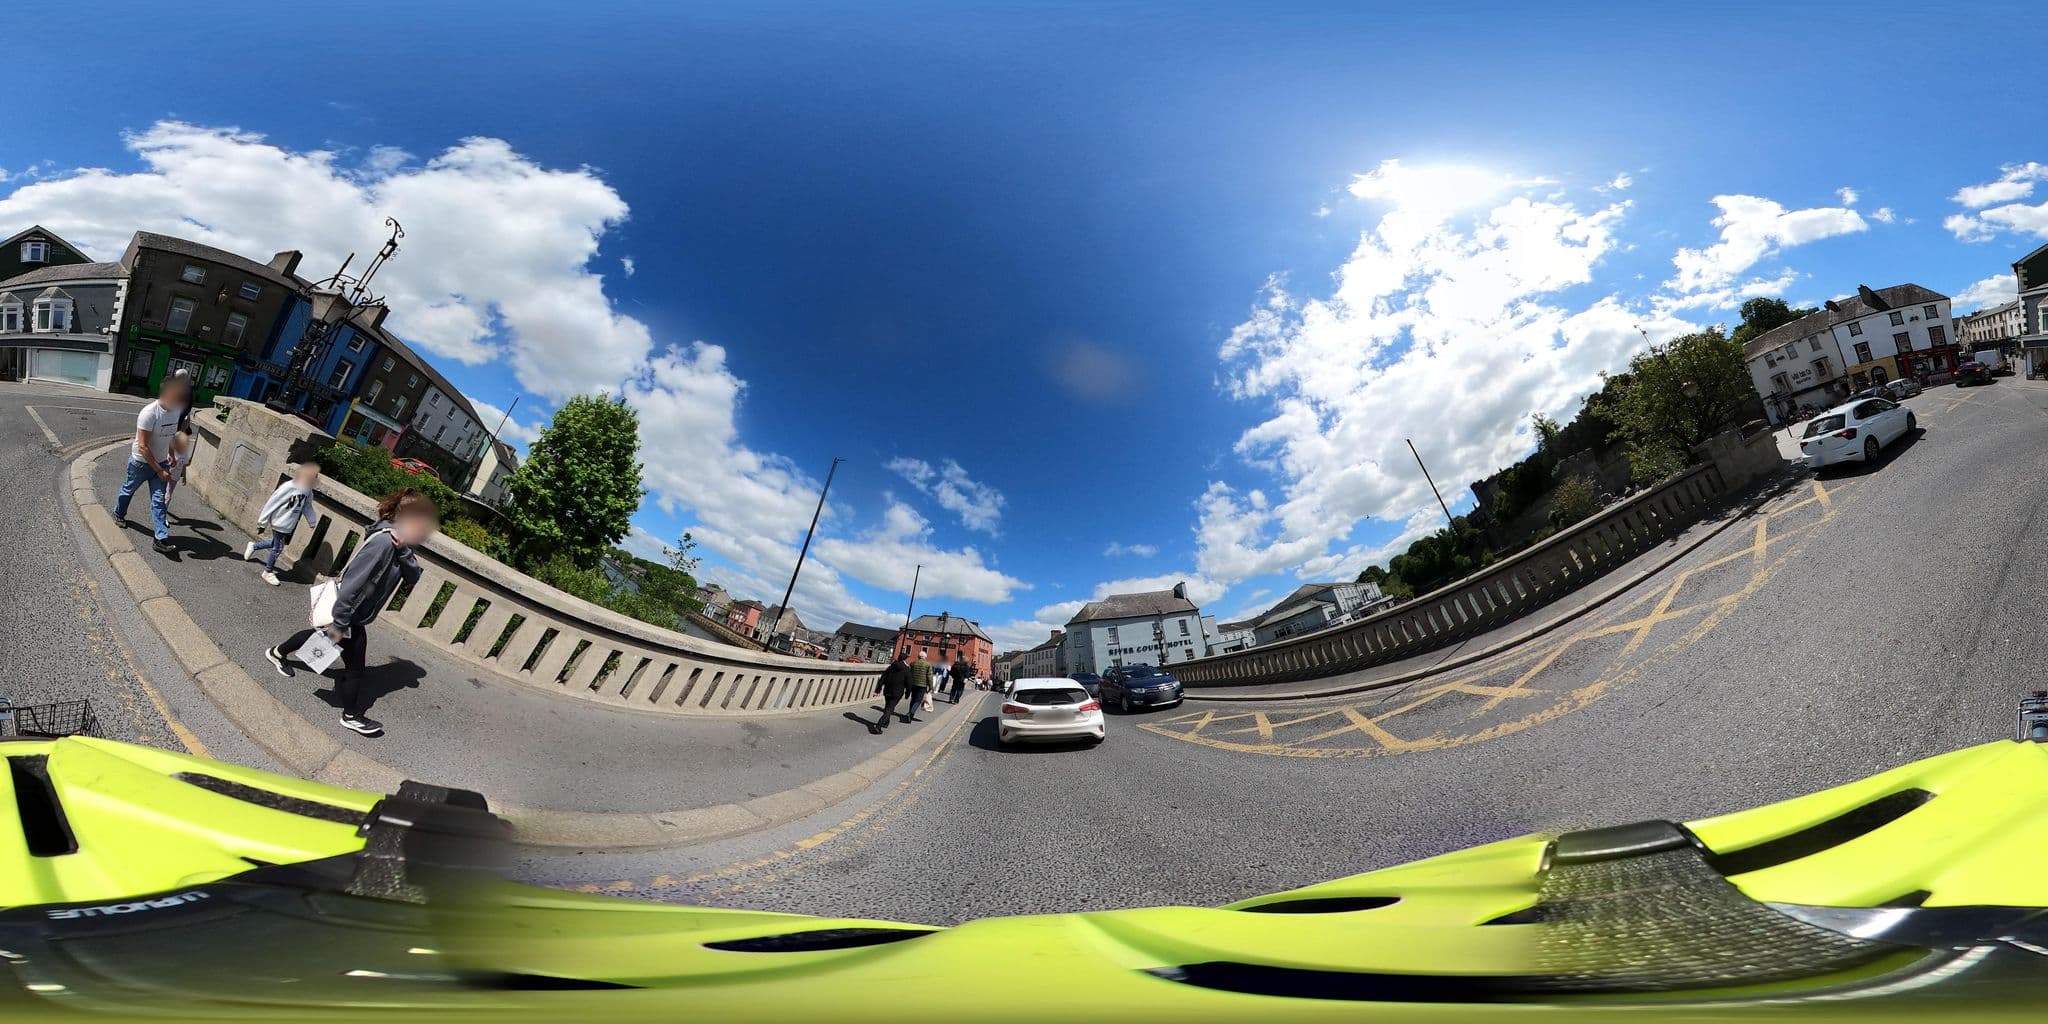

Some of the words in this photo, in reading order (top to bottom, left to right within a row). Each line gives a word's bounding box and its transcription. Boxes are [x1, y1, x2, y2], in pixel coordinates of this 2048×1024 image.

[1108, 647, 1134, 656] RIVER
[1136, 643, 1164, 653] COURT
[1167, 639, 1194, 648] HOTEL
